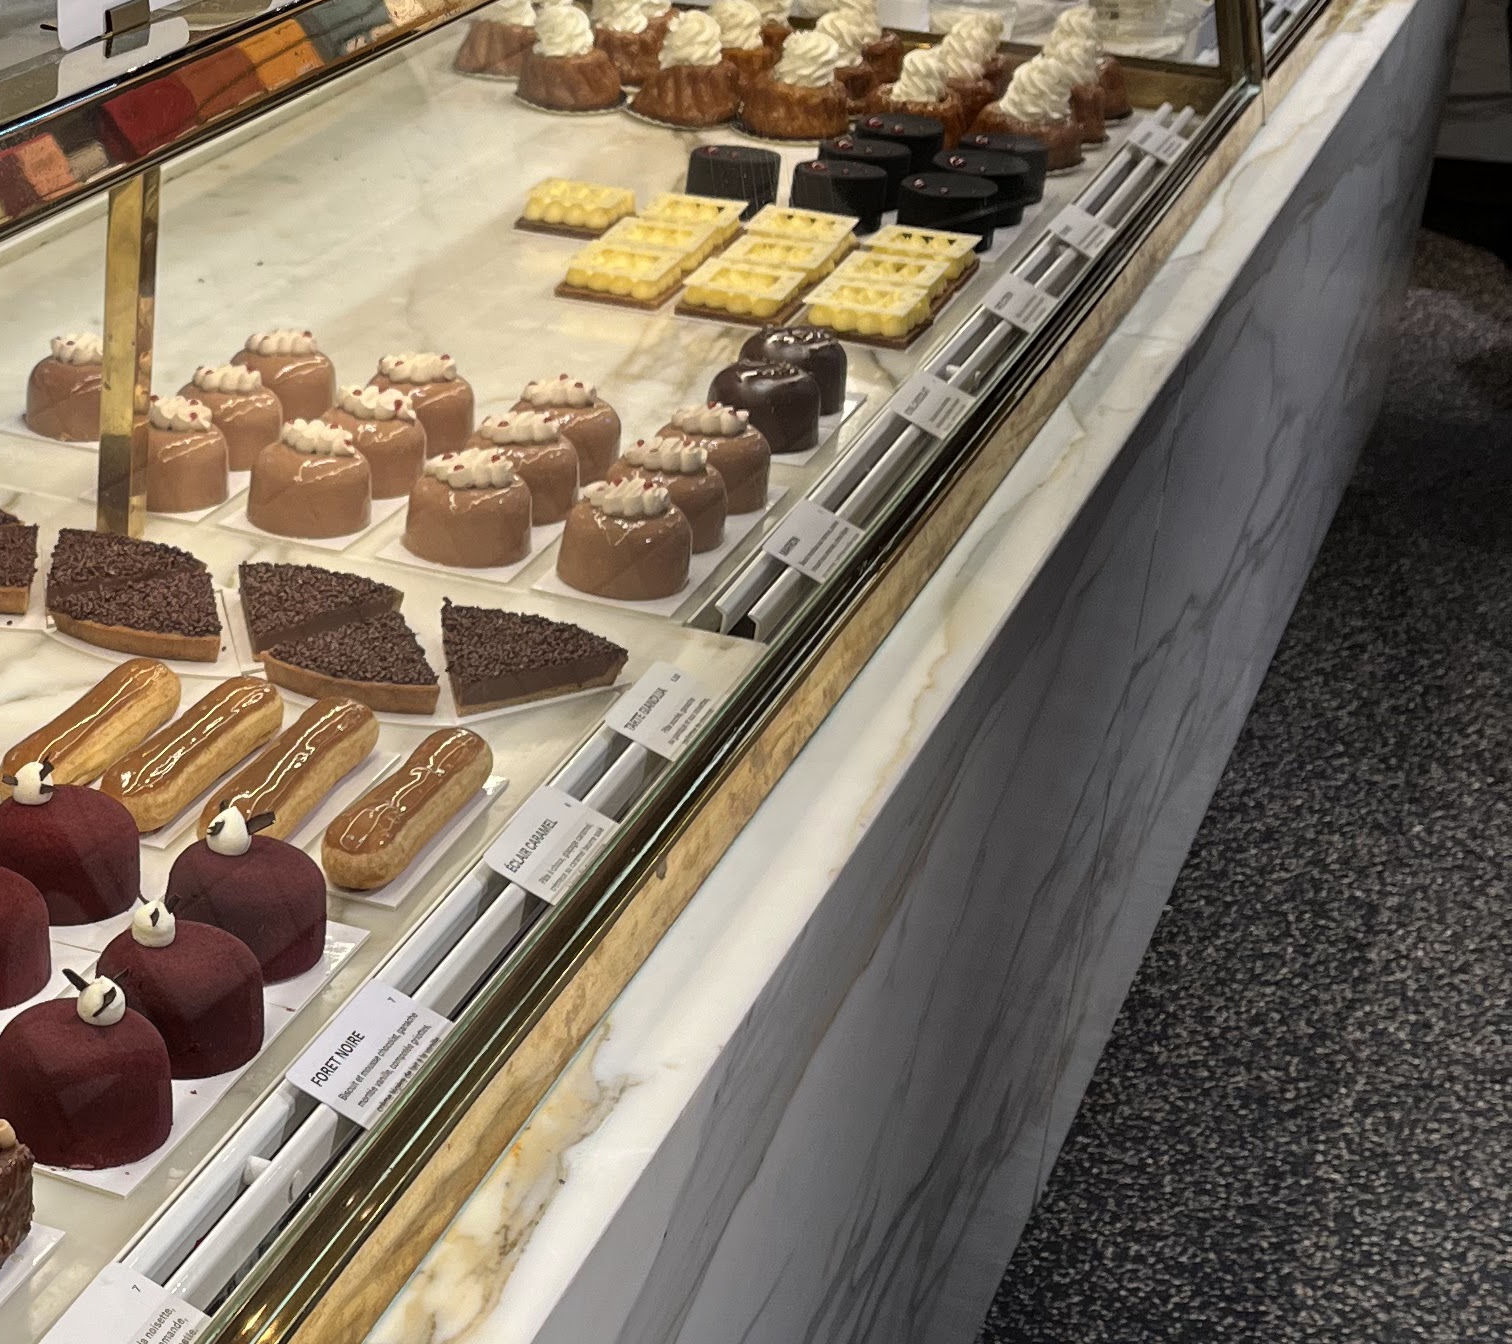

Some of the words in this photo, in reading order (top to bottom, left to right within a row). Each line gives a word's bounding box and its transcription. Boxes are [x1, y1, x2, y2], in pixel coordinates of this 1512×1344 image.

[503, 847, 533, 874] ÉCLAIR
[524, 818, 559, 851] CARAMEL
[310, 1055, 342, 1088] FORET
[334, 1030, 366, 1059] NOIRE
[131, 1284, 141, 1293] 7
[145, 1308, 176, 1340] noisette,
